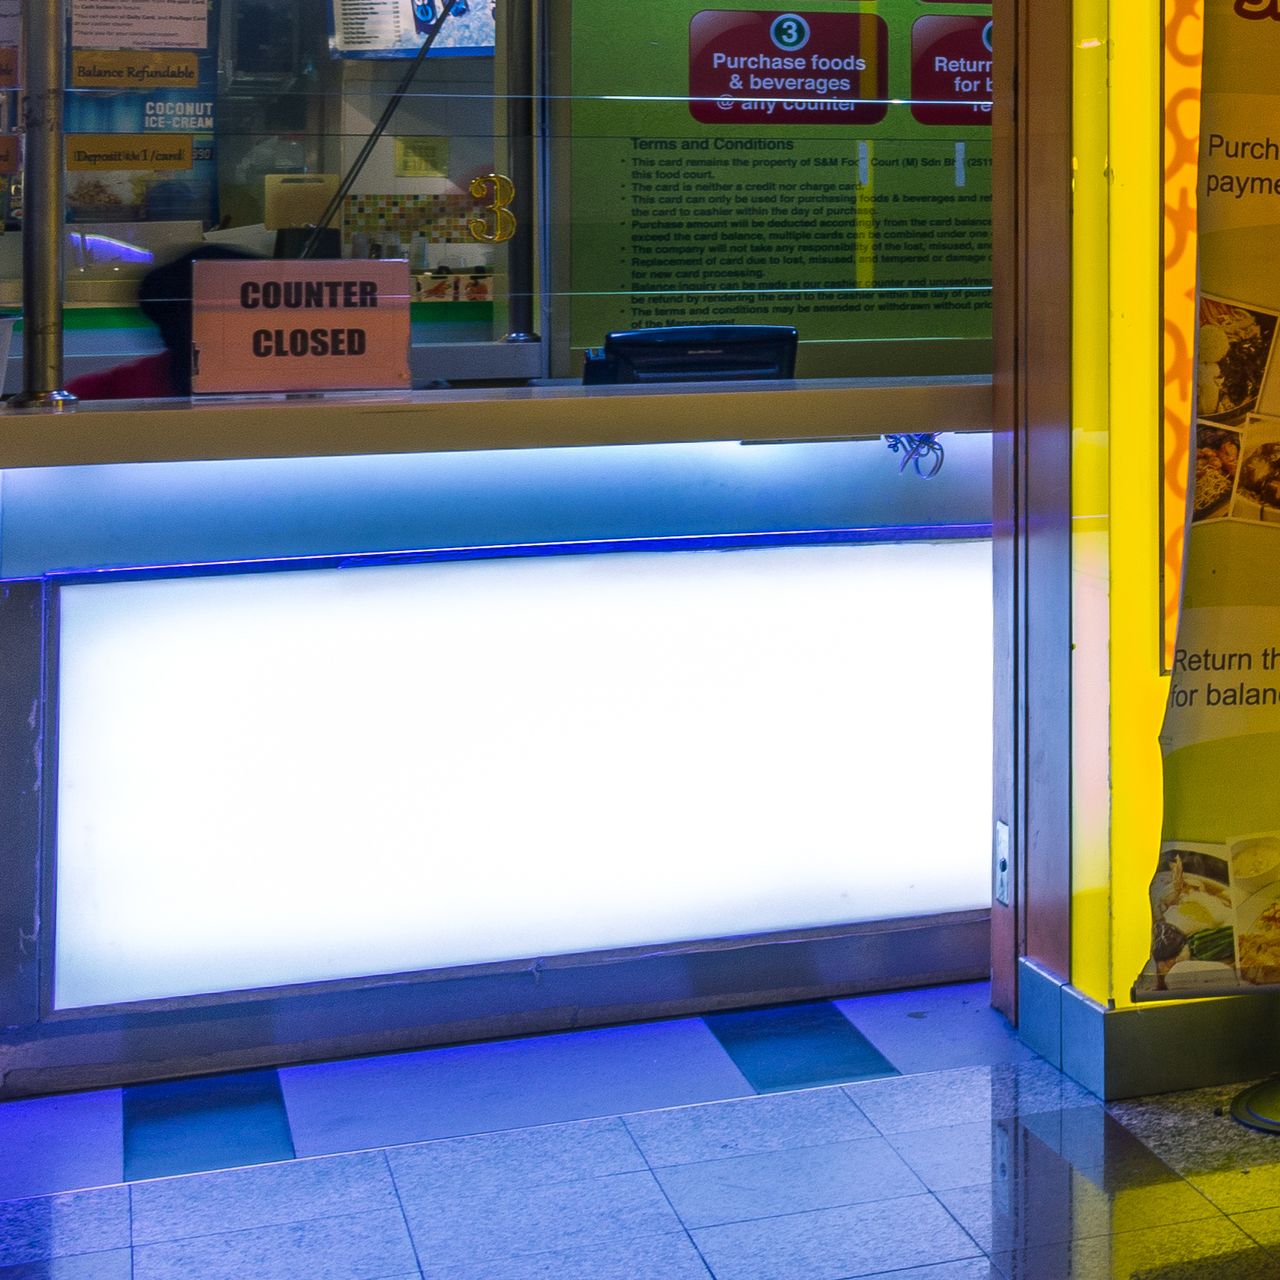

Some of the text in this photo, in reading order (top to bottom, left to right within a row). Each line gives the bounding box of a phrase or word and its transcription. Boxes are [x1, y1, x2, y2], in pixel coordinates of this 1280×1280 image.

[781, 21, 798, 43] 3
[713, 52, 806, 70] Purchase
[811, 54, 866, 71] foods
[78, 65, 194, 81] Balance Refundable
[729, 74, 978, 93] & beverages for
[145, 102, 213, 115] COCONUT
[145, 117, 214, 129] ICE-CREAM
[630, 137, 794, 151] Terms and Conditions
[469, 174, 518, 244] 3
[240, 280, 378, 310] COUNTER
[252, 329, 367, 359] CLOSED
[1172, 648, 1253, 673] Return
[1170, 683, 1198, 708] for
